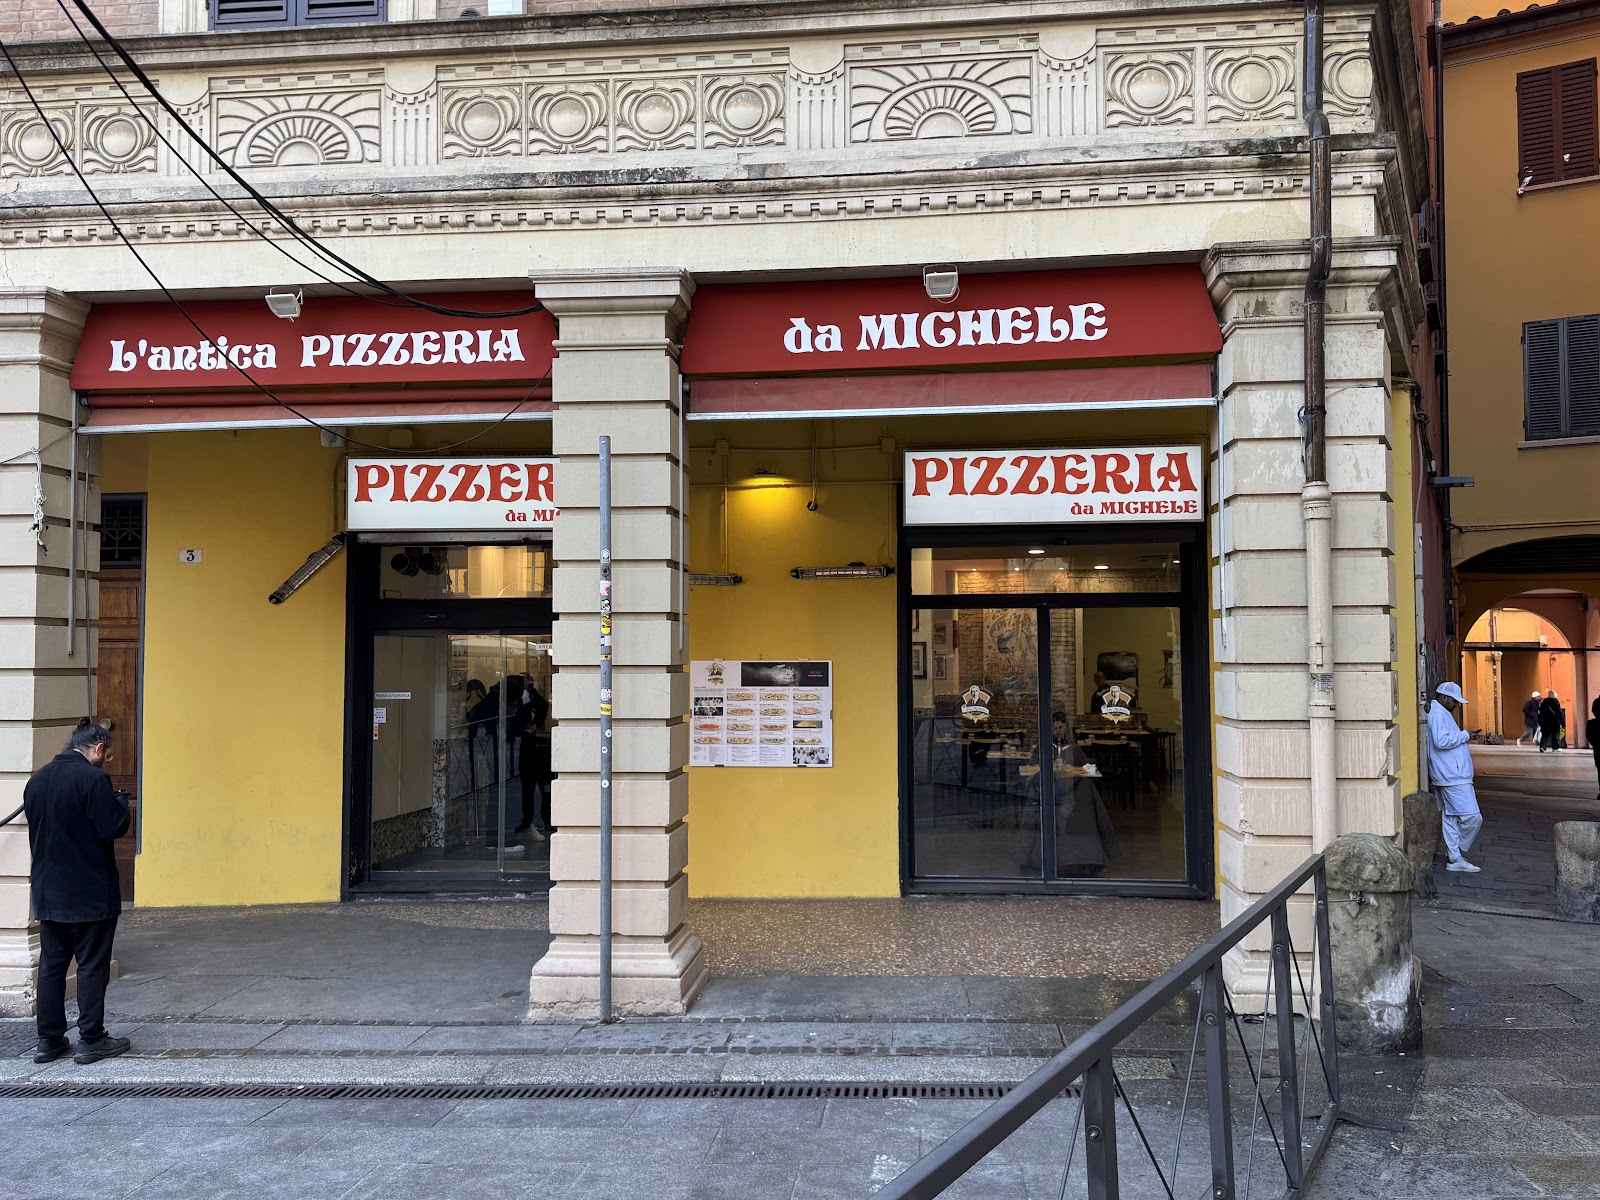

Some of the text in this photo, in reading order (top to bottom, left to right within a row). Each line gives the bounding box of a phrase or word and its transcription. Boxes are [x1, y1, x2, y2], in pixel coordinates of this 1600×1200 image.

[783, 301, 1109, 354] da MICHELE
[108, 328, 525, 372] L'antica PIZZERIA
[912, 453, 1197, 497] PIZZERIA
[505, 509, 561, 522] da MI
[1070, 499, 1198, 515] da MICHELE
[186, 549, 195, 562] 3
